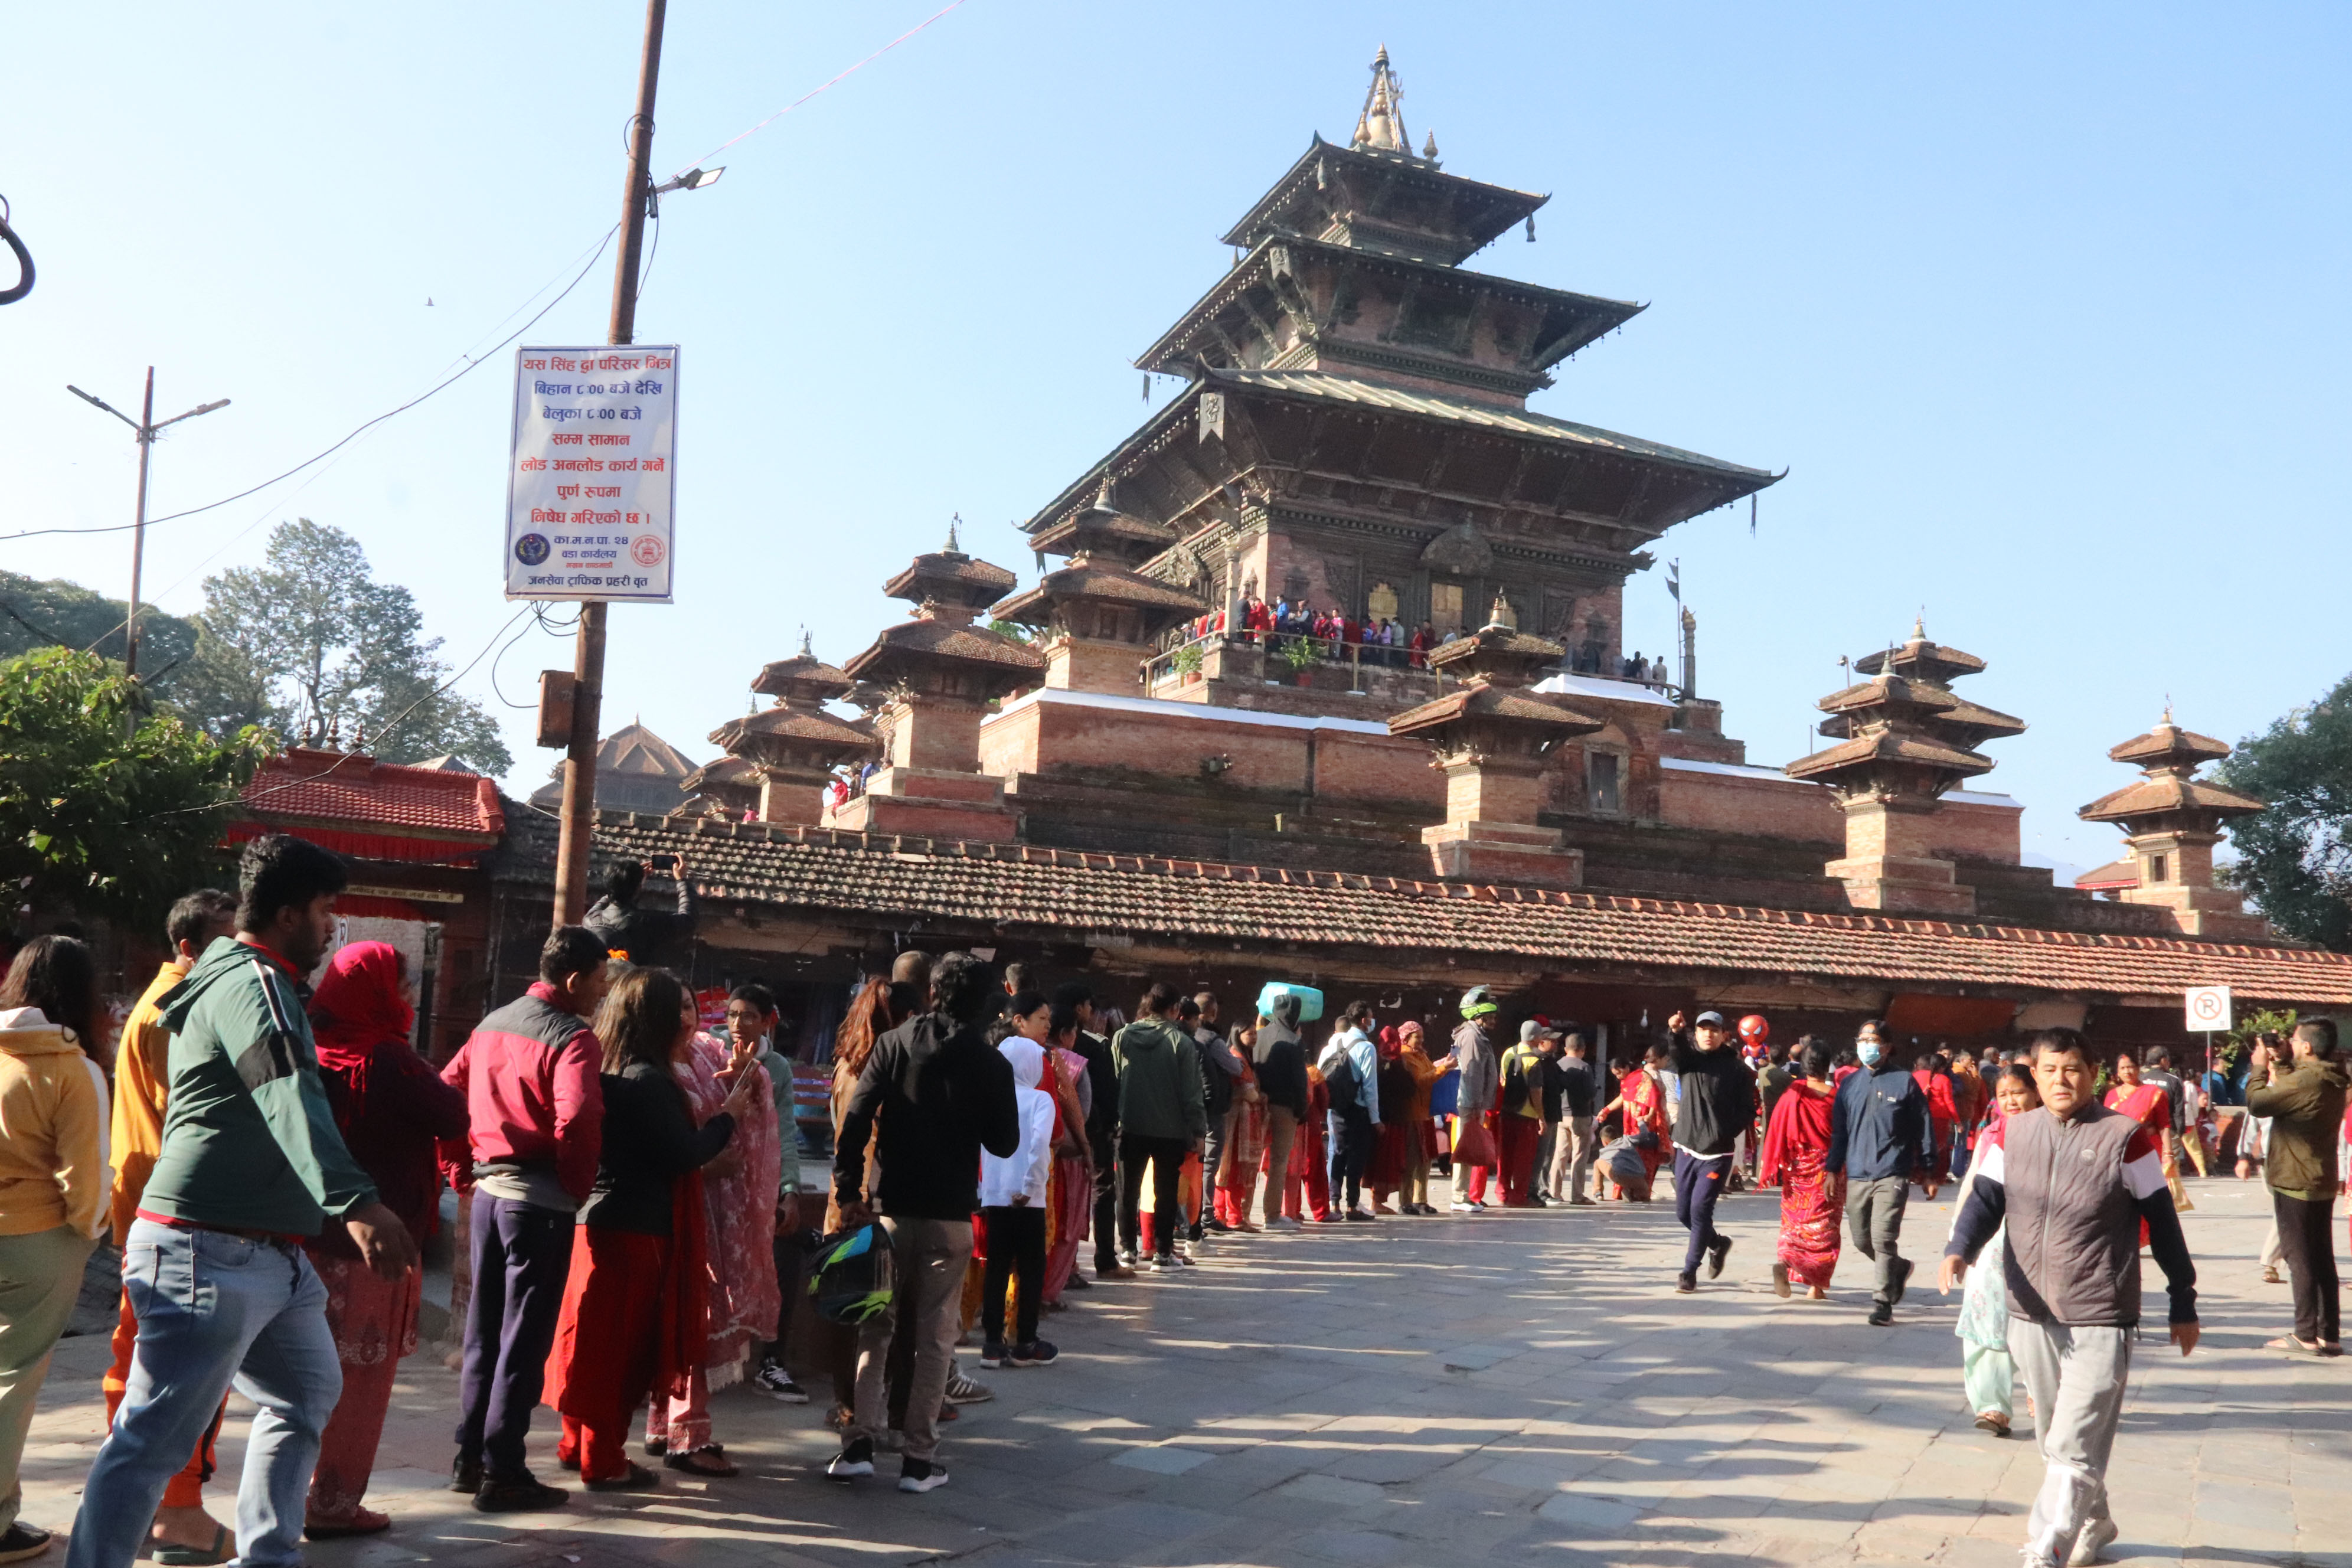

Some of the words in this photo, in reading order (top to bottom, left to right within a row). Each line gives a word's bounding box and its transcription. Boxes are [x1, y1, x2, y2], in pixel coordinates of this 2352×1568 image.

[524, 359, 547, 371] यस
[551, 357, 577, 371] सिंह
[599, 356, 641, 371] परिसर
[645, 355, 672, 370] भित्र
[534, 380, 571, 395] बिहान
[609, 381, 631, 394] बजे
[635, 380, 662, 395] देखि
[543, 406, 582, 422] बेलुका
[620, 406, 642, 420] बजे
[552, 433, 583, 445] सम्म
[587, 435, 631, 446] सामान
[521, 457, 548, 472] लोड
[553, 457, 604, 472] अनलोड
[609, 458, 638, 472] कार्य
[557, 484, 580, 500] पुर्ण
[571, 509, 621, 524] गरिएको
[626, 512, 639, 524] छ
[615, 537, 629, 545] २४
[528, 574, 564, 586] जनसेवा
[567, 574, 602, 587] ट्राफिक
[606, 575, 631, 586] प्रहरी
